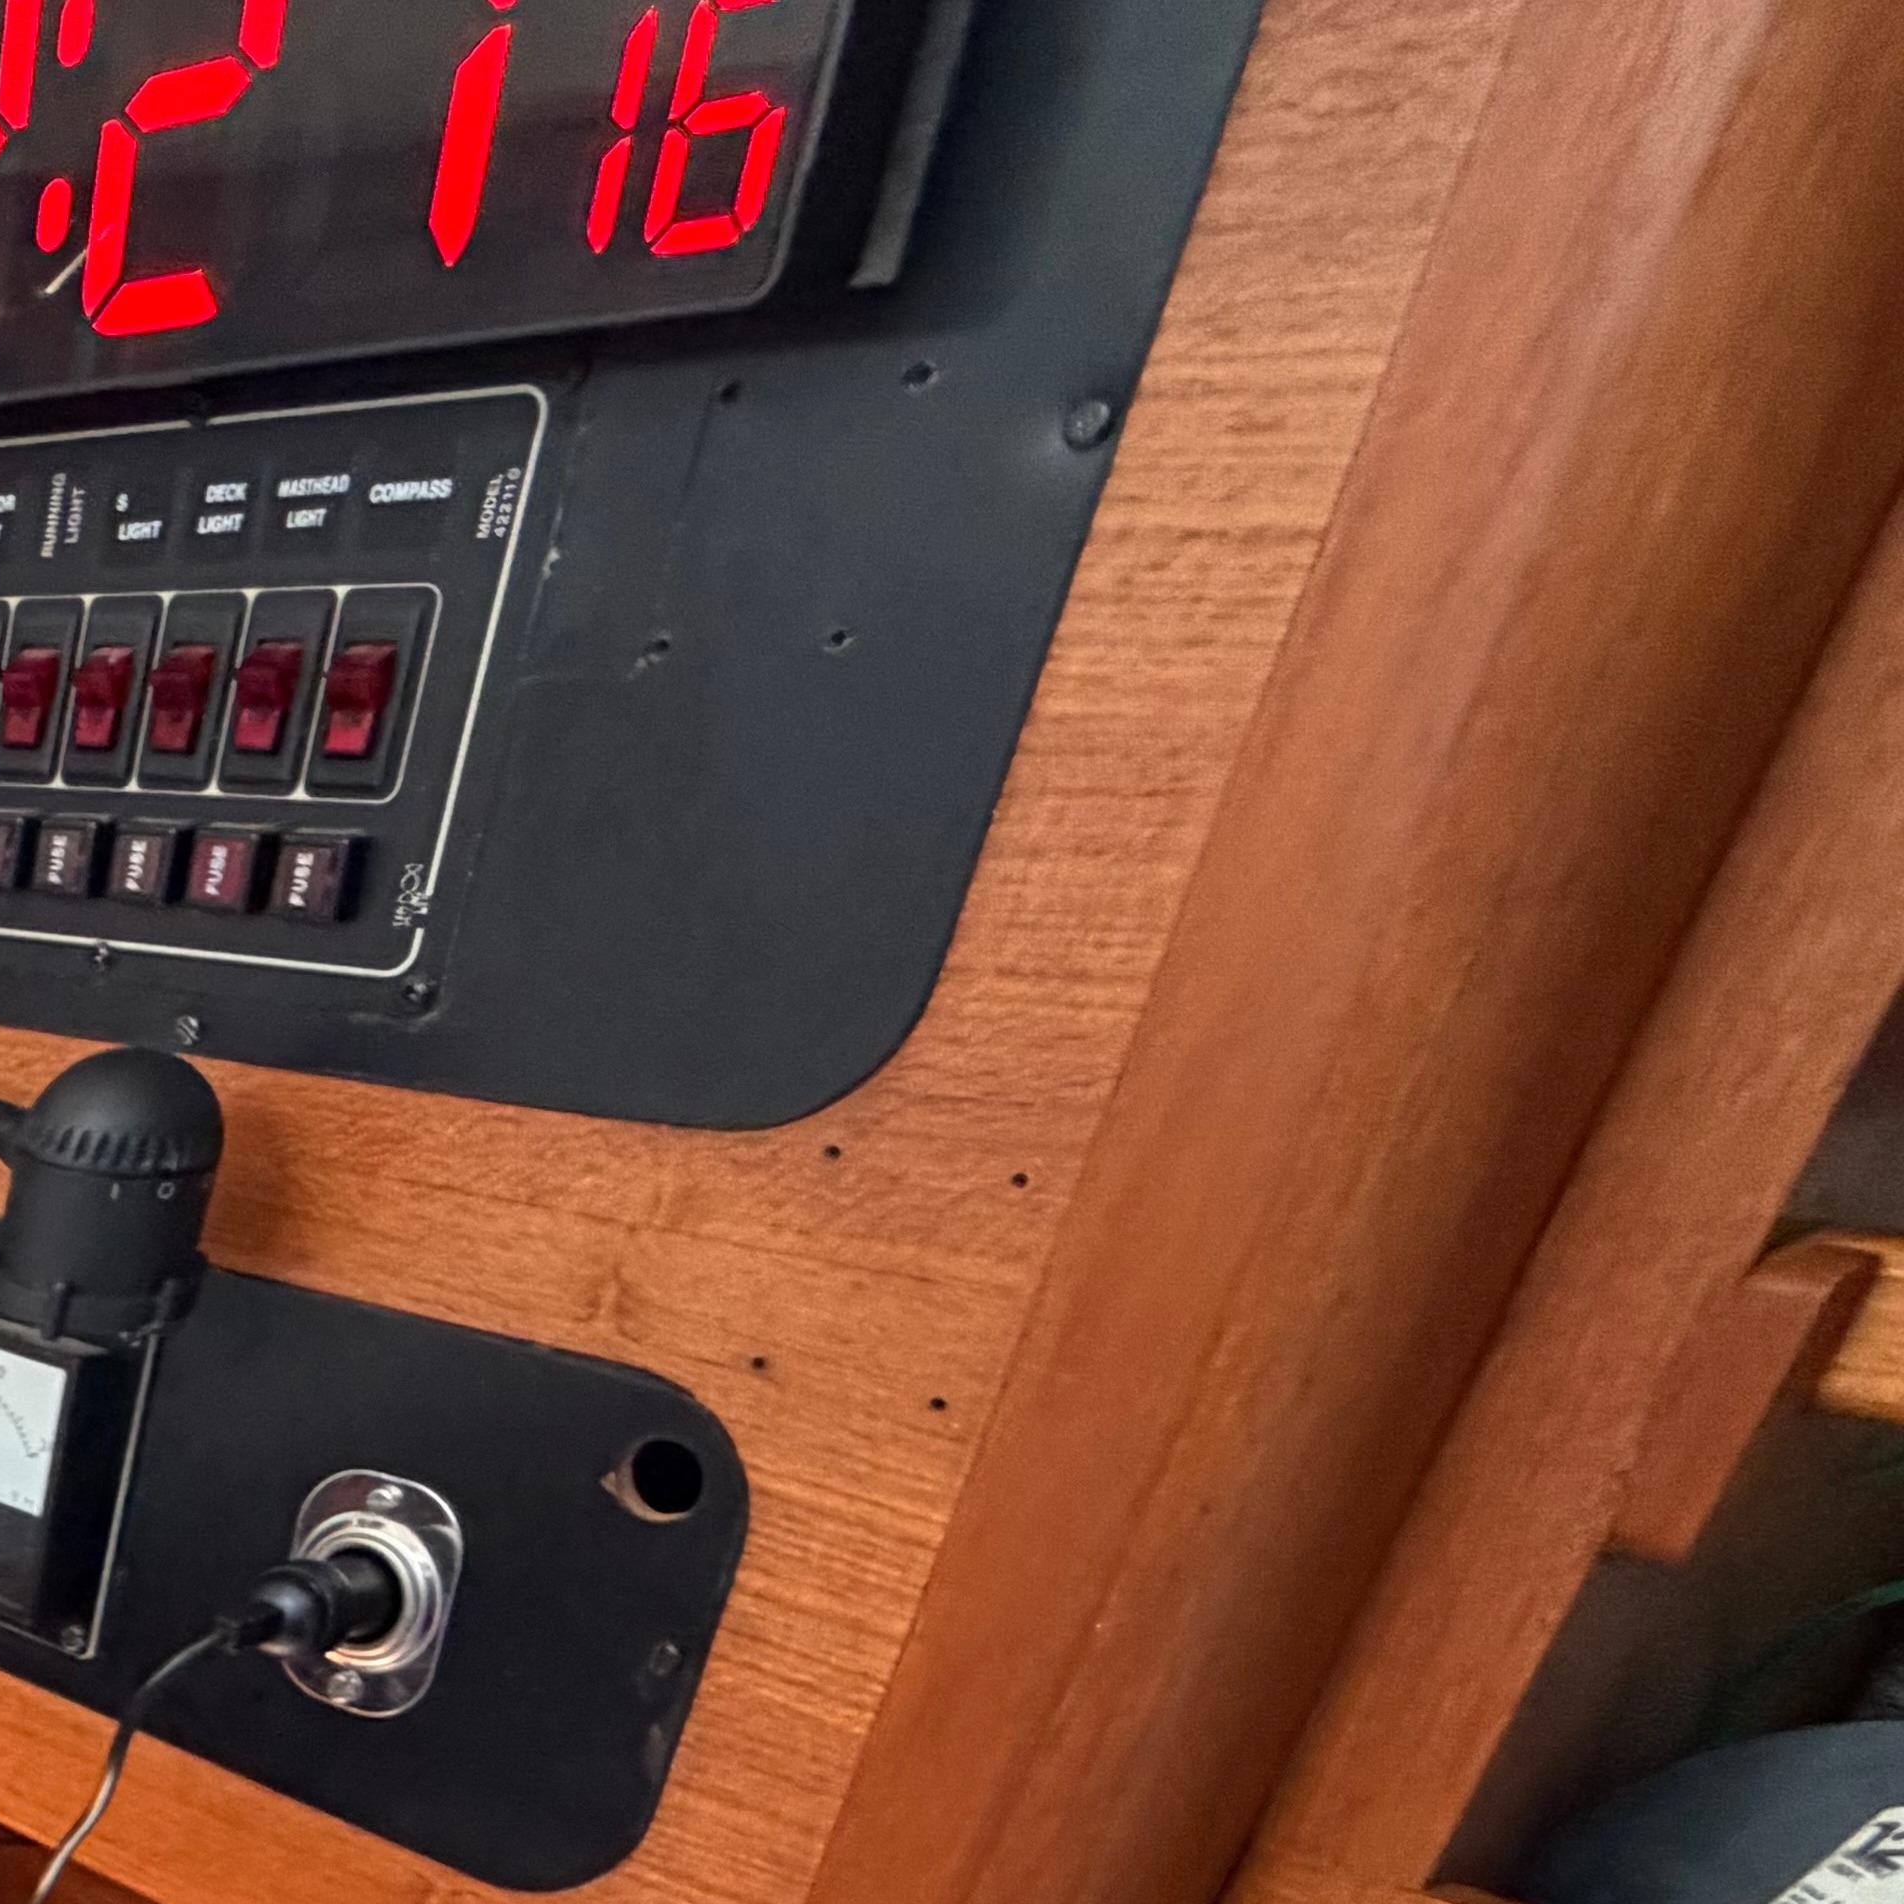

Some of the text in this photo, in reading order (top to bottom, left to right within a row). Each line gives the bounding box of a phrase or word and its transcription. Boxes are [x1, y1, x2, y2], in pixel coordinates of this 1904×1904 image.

[586, 0, 789, 259] 16
[205, 482, 248, 503] DECK
[277, 474, 351, 498] MASTHEAD
[369, 479, 453, 503] COMPASS
[64, 486, 86, 544] LIGHT
[116, 493, 129, 513] S
[117, 520, 163, 541] LIGHT
[197, 513, 244, 534] LIGHT
[286, 508, 327, 529] LIGHT
[48, 834, 68, 885] FUSE
[125, 840, 147, 892] FUSE
[204, 845, 228, 896] FUSE
[288, 851, 314, 907] FUSE
